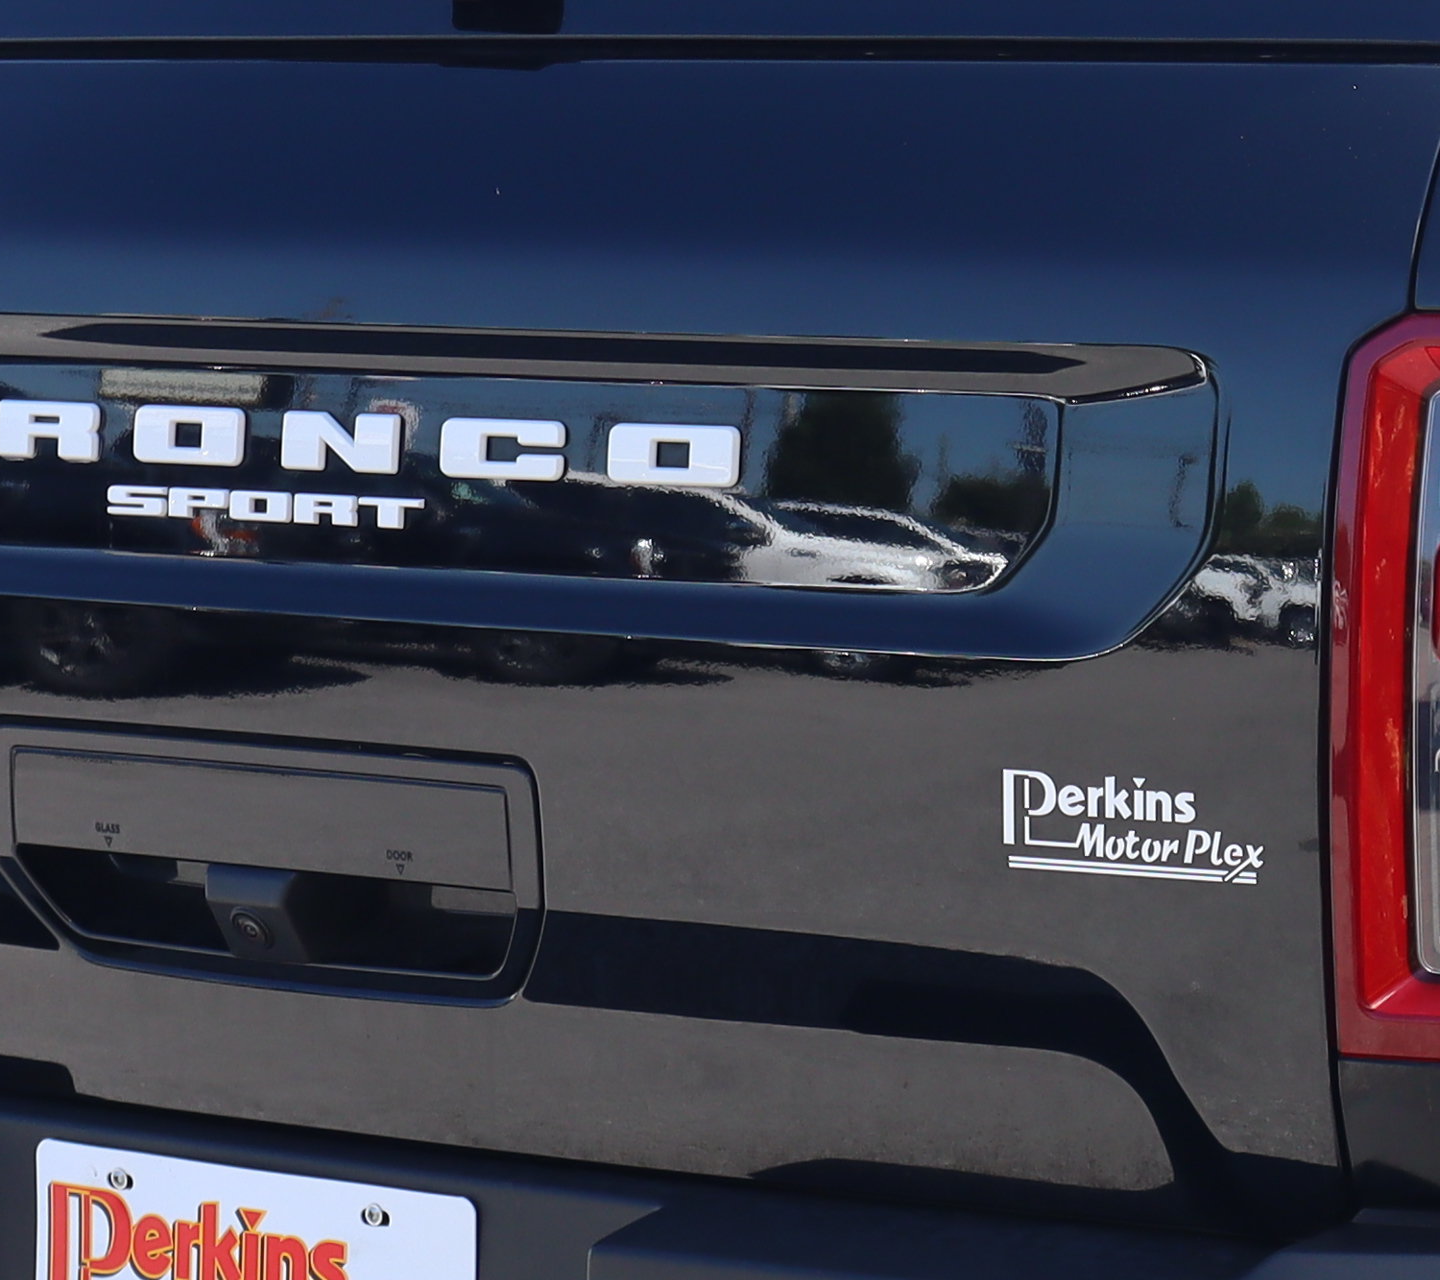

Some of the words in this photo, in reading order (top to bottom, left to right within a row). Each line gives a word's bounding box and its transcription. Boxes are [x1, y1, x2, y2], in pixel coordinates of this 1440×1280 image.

[107, 484, 425, 529] SPORT
[95, 821, 120, 834] GLASS
[1003, 768, 1197, 845] Perkins
[386, 849, 413, 863] DOOR
[1076, 823, 1180, 862] Motor
[1184, 829, 1264, 882] Plex
